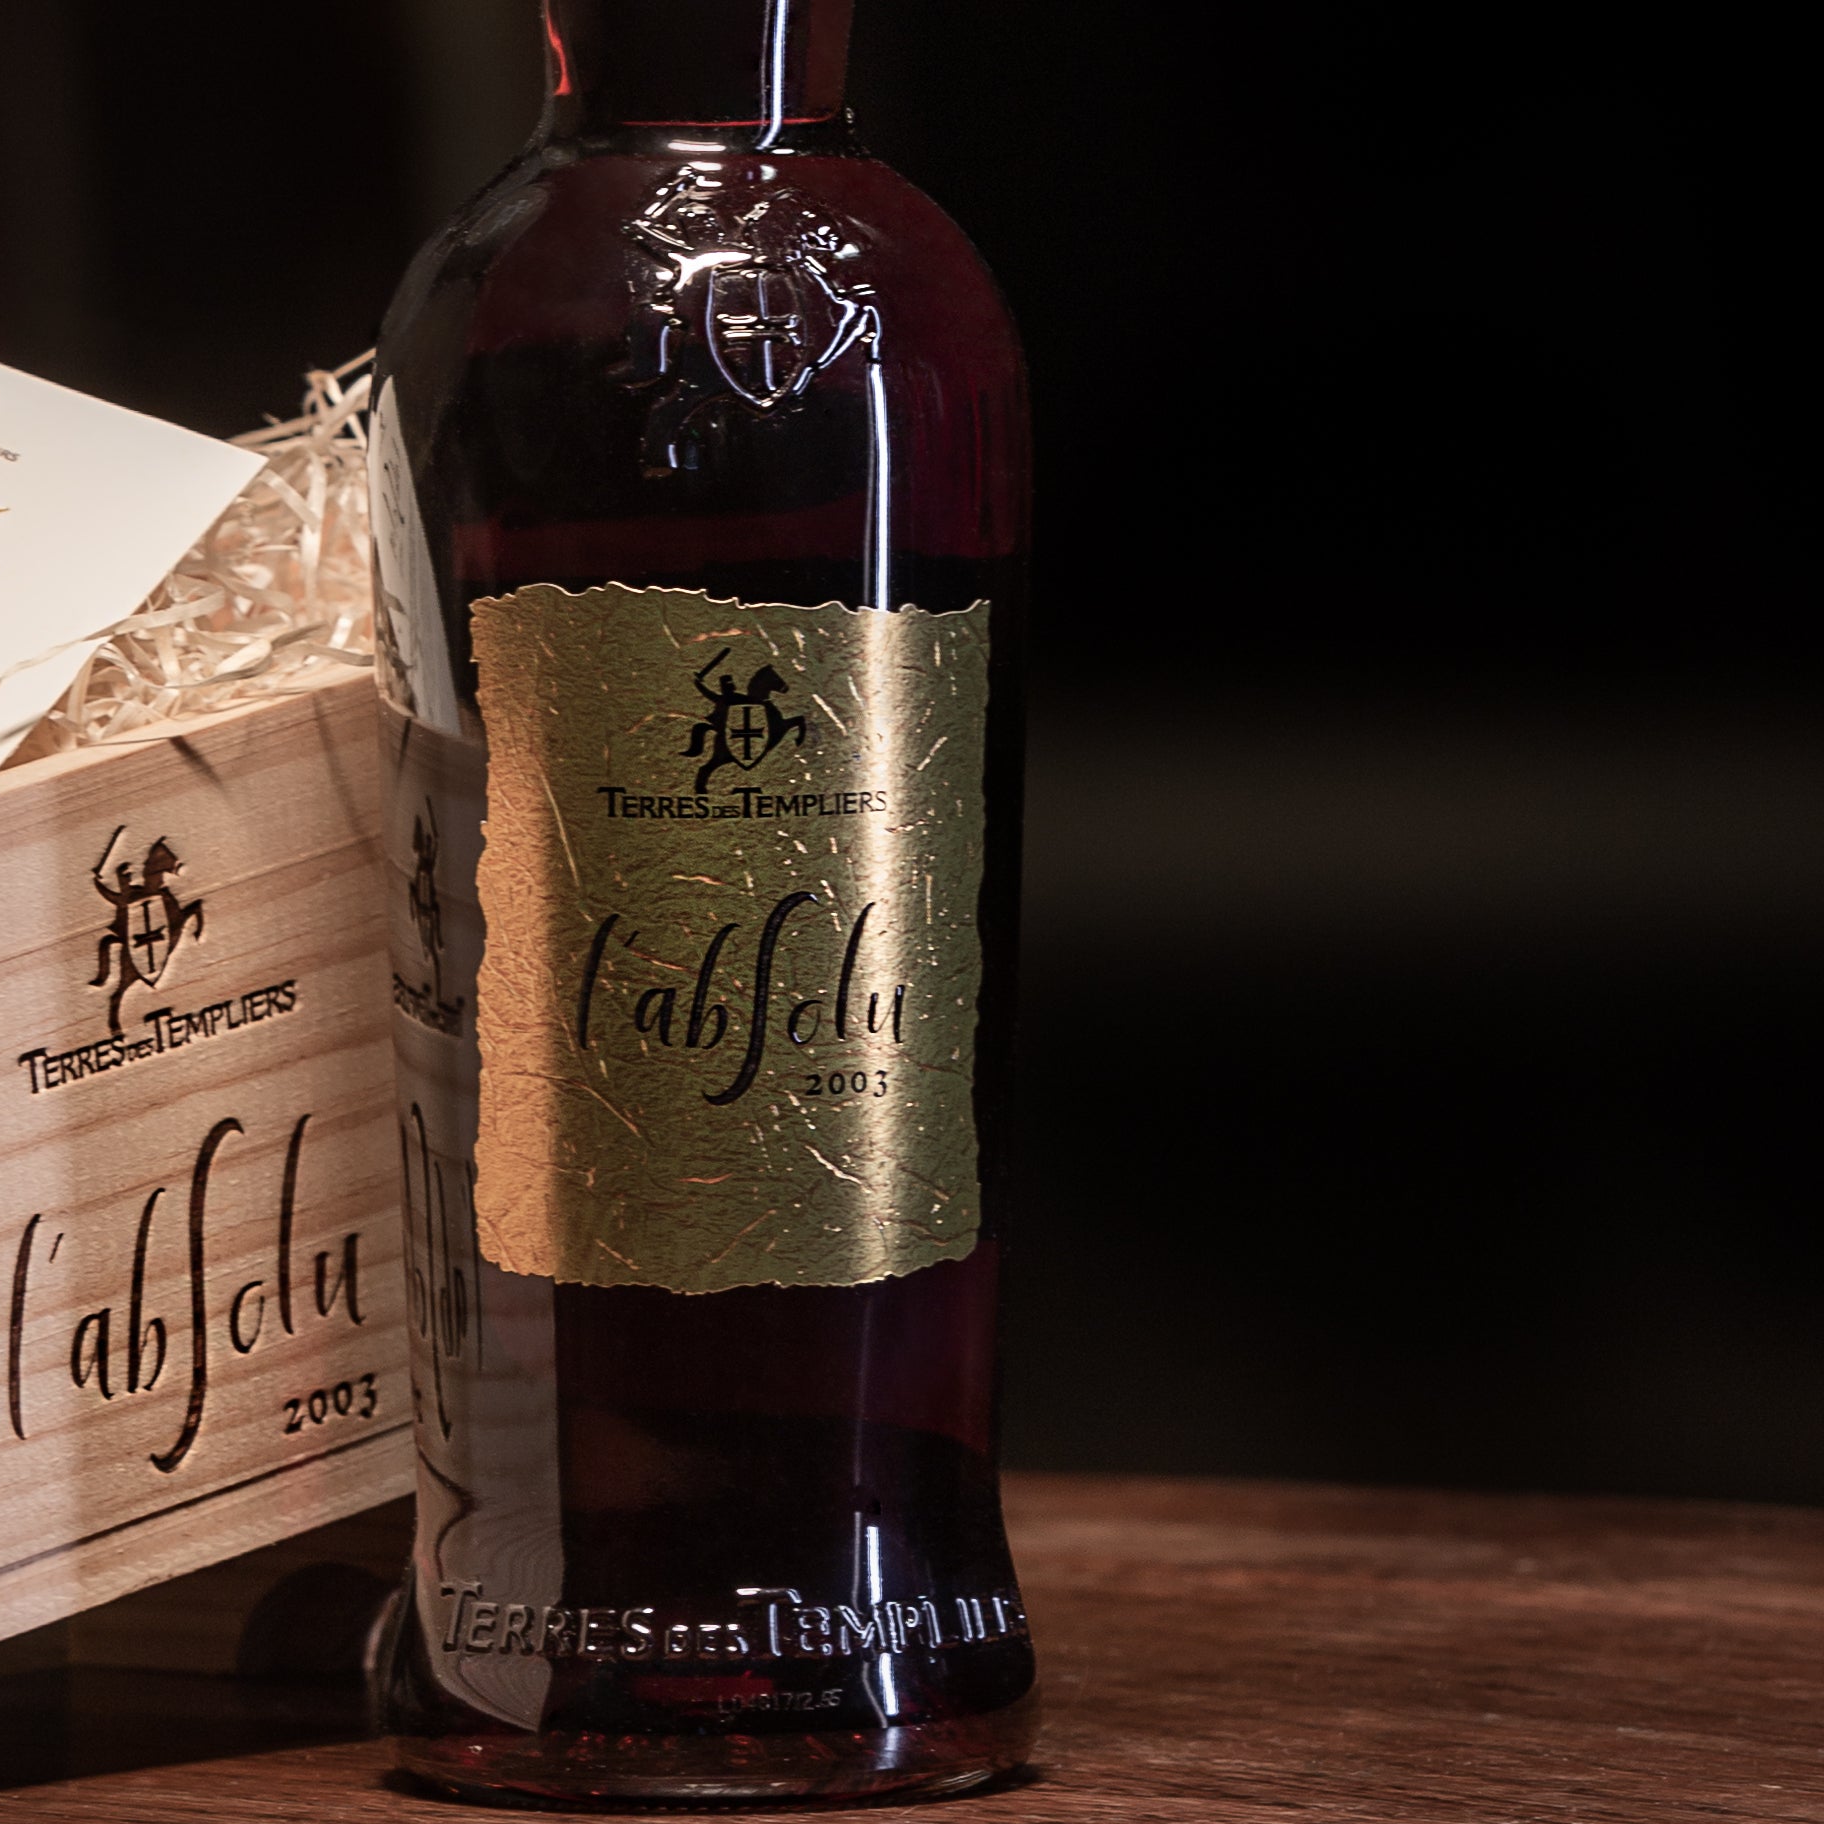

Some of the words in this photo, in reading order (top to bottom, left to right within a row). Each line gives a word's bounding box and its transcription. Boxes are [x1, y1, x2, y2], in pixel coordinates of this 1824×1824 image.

[597, 786, 709, 818] TERRES
[731, 786, 888, 819] TEMPLIERS
[17, 1034, 126, 1094] TERRES
[143, 979, 298, 1054] TEMPLIERS
[804, 1069, 890, 1097] 2003
[283, 1372, 378, 1435] 2003
[440, 1579, 656, 1656] TERRES
